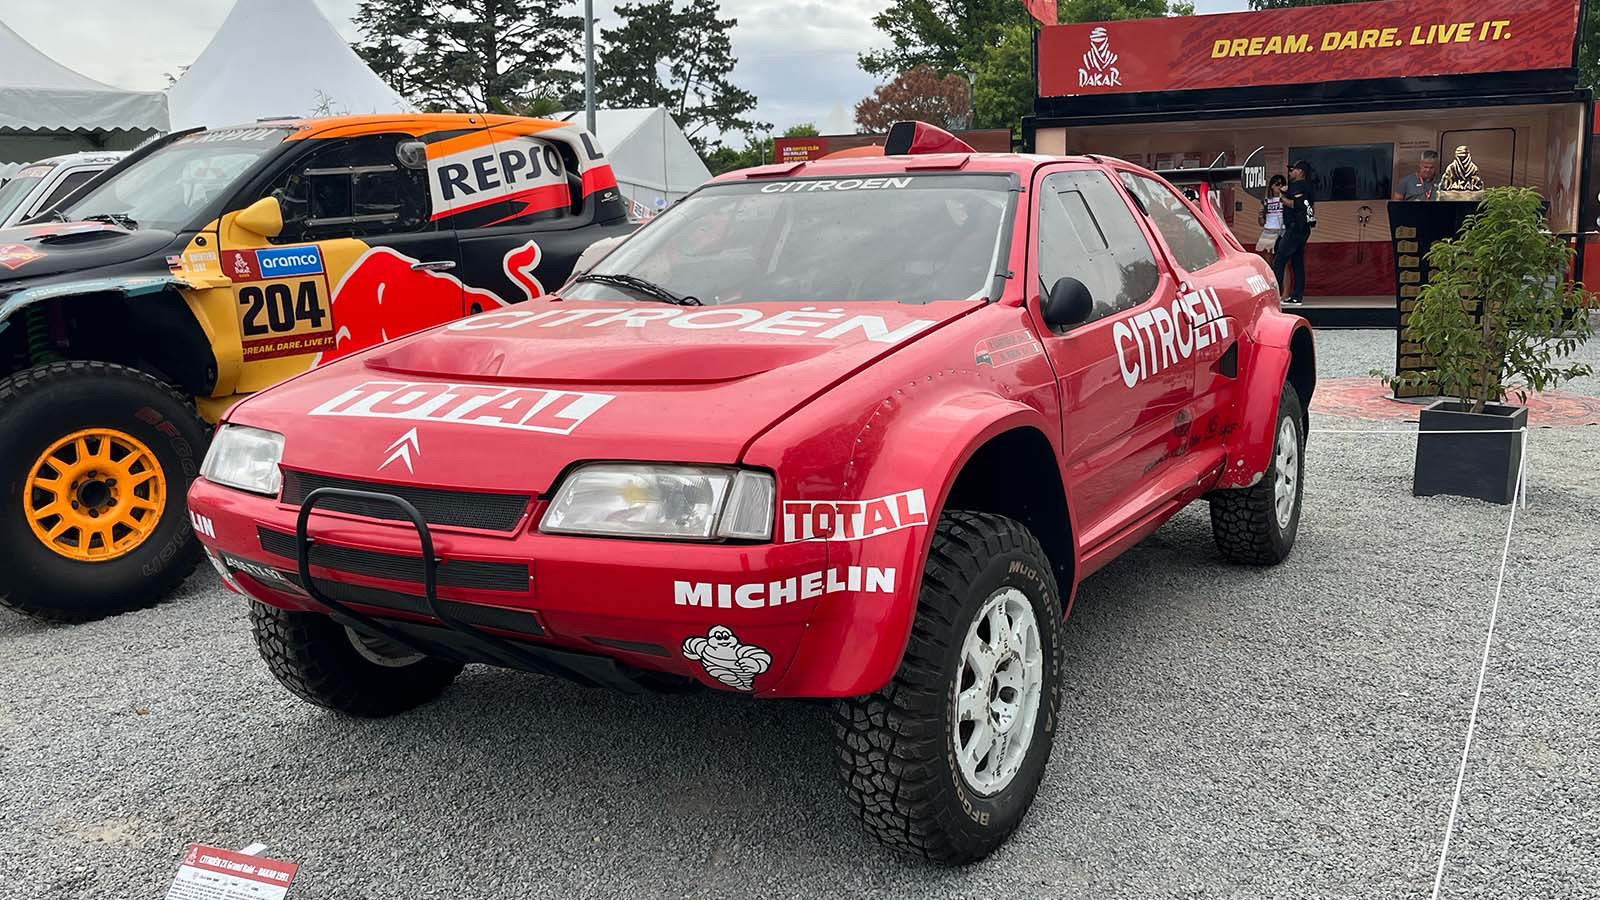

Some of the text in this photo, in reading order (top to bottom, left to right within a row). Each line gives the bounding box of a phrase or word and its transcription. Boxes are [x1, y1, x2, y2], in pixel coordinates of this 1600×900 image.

[1211, 20, 1511, 58] DREAM. DARE. LIVE IT.
[1078, 67, 1122, 87] DAKAR
[437, 133, 603, 200] REPSOL
[1245, 166, 1267, 189] TOTAL
[262, 253, 318, 269] aramco
[238, 280, 326, 336] 204
[447, 306, 936, 343] CITROËN
[276, 341, 302, 351] DARE.
[304, 338, 324, 347] LIVE
[323, 336, 334, 345] IT.
[330, 384, 584, 430] TOTAL
[785, 494, 926, 537] TOTAL
[674, 566, 896, 609] MICHELIN
[1008, 560, 1058, 677] Mud-Terrain
